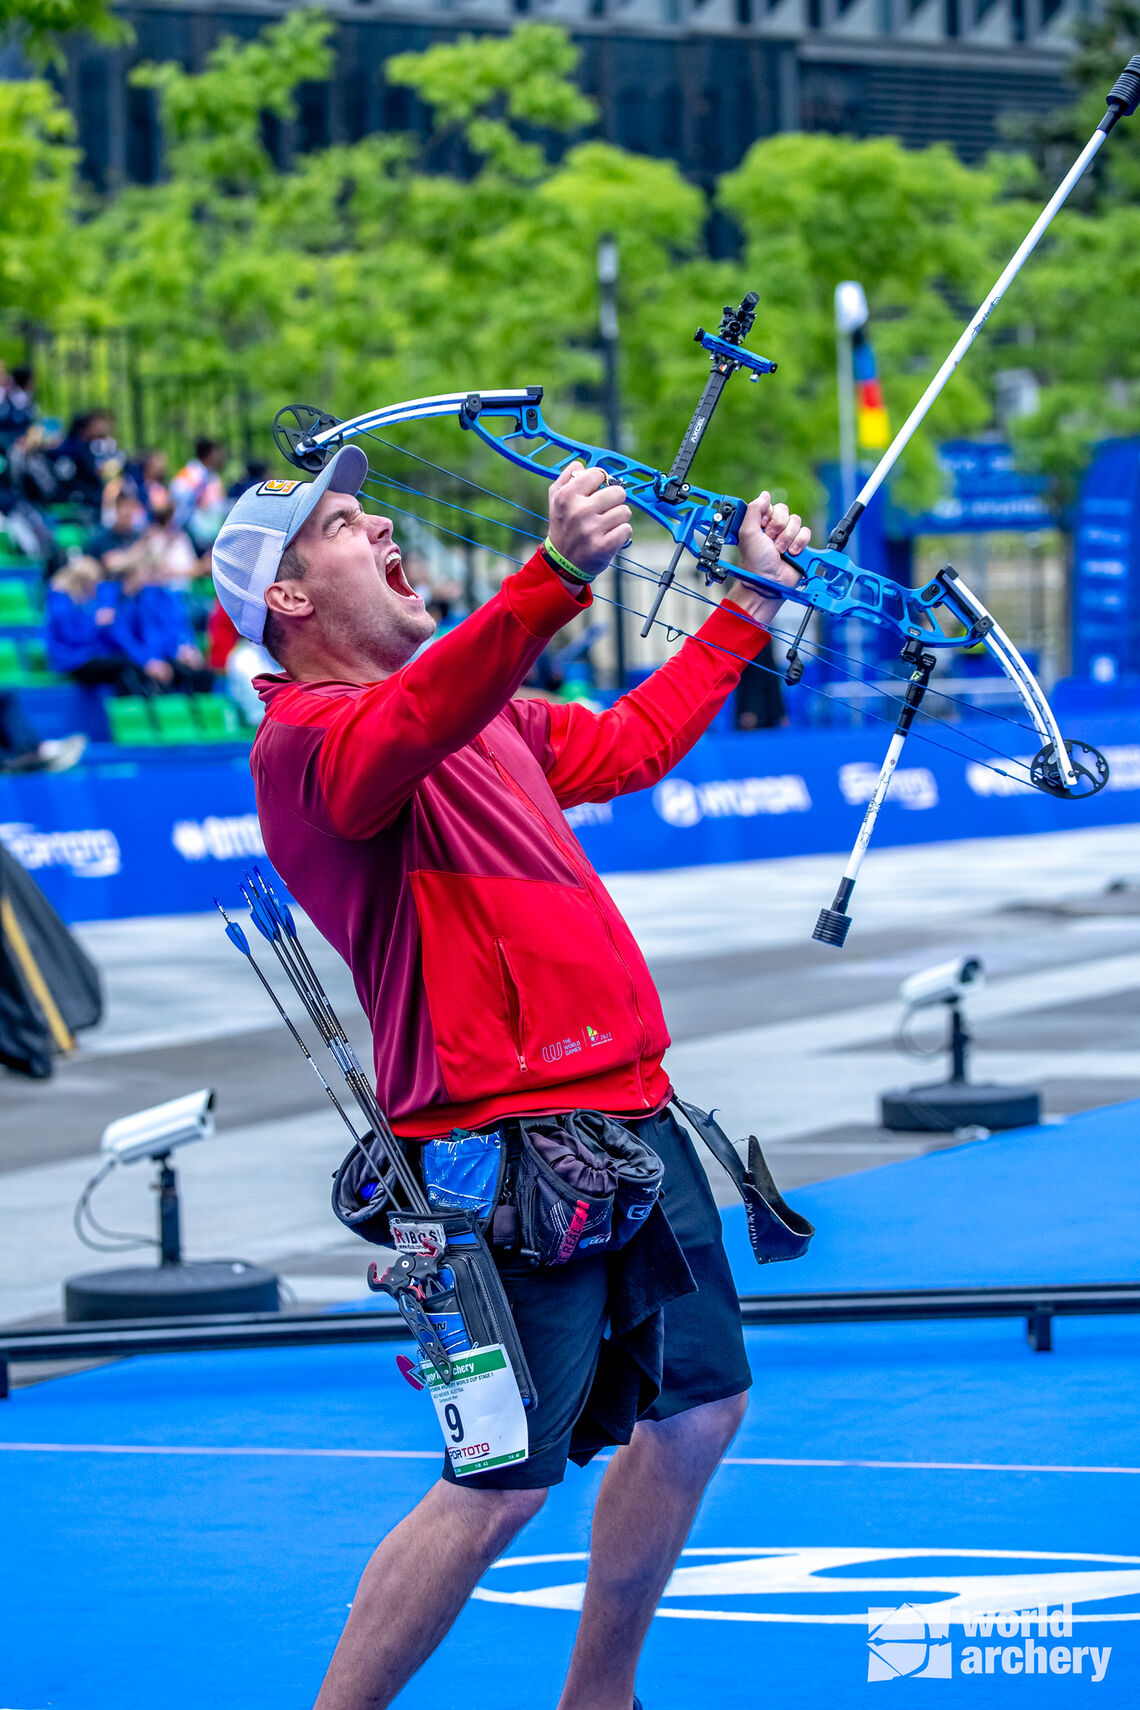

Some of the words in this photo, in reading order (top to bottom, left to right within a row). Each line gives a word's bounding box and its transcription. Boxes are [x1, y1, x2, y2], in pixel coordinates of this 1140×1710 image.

[691, 417, 706, 443] AXCEL
[564, 1040, 581, 1050] WORLD
[565, 1046, 582, 1056] GAMES
[445, 1403, 464, 1443] 9
